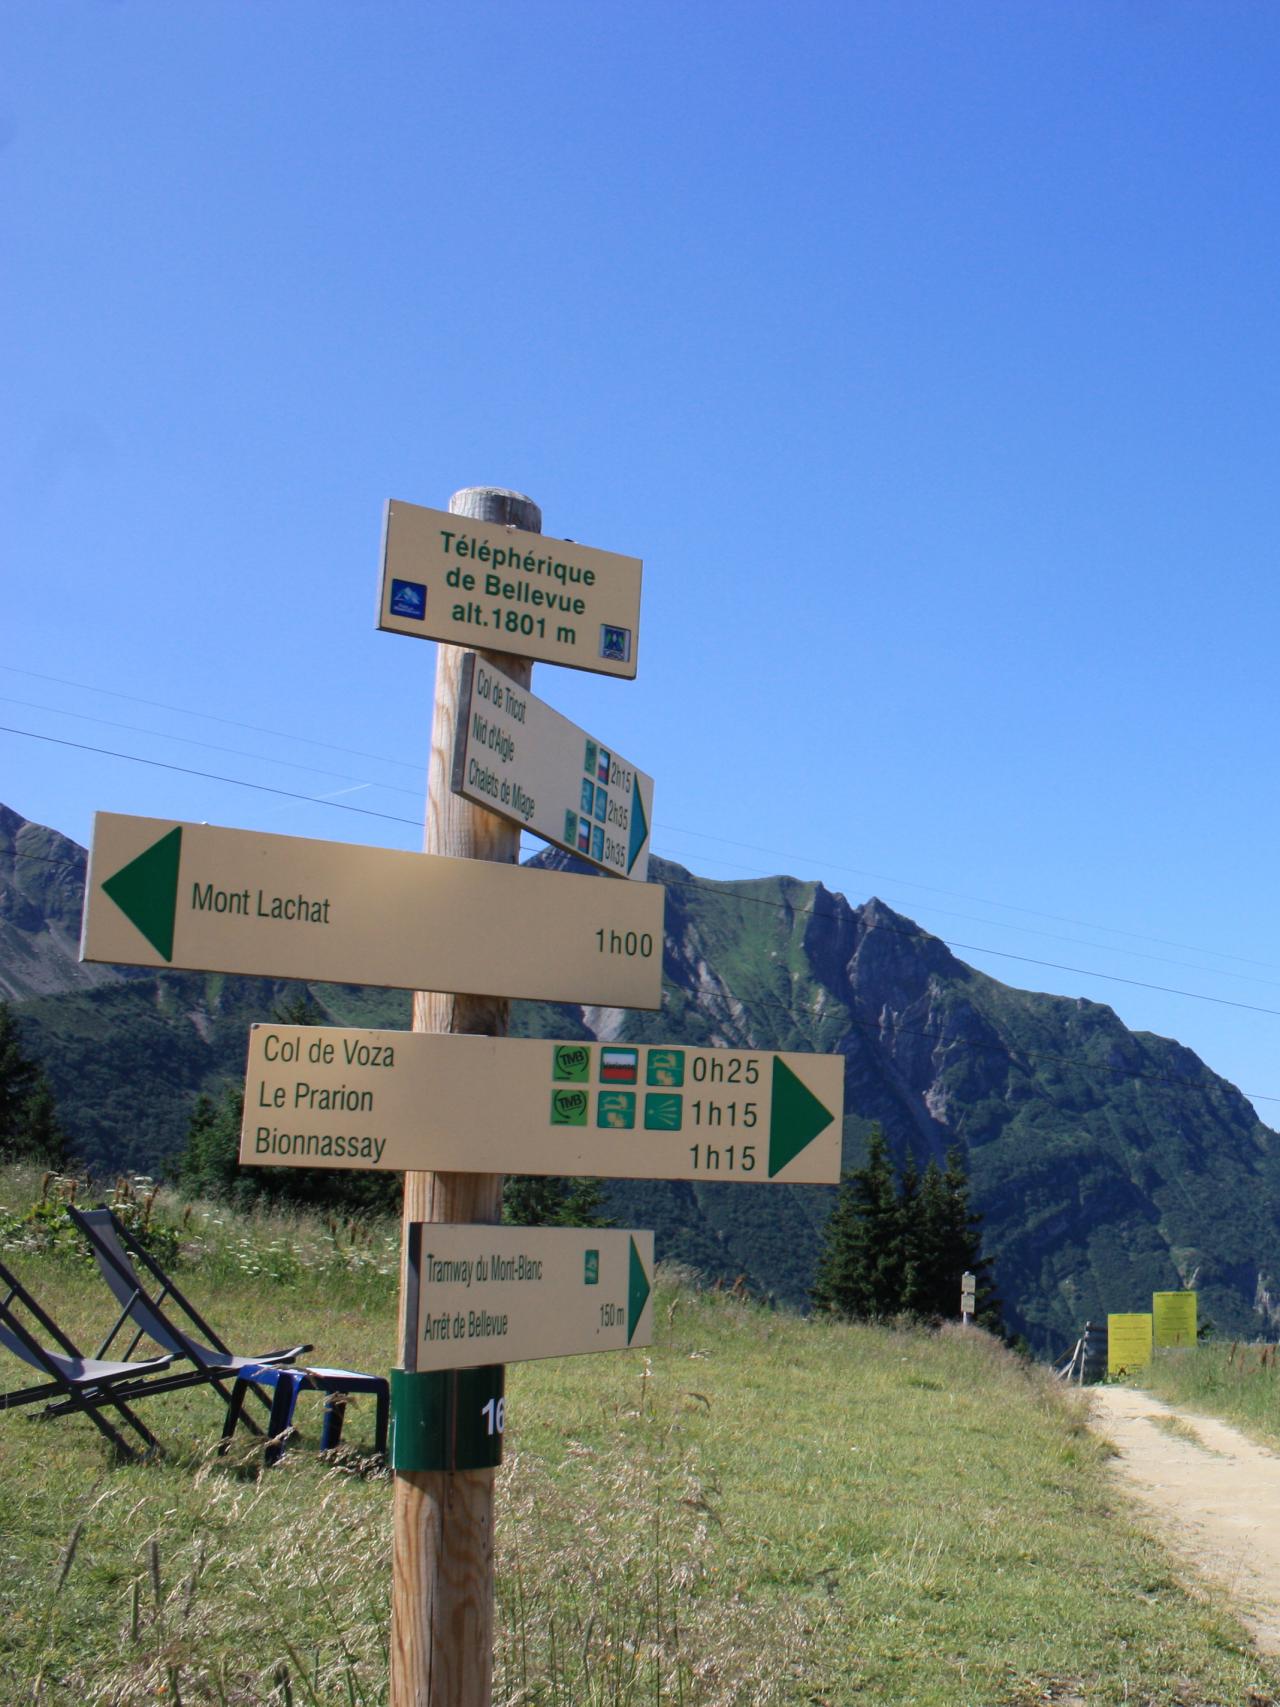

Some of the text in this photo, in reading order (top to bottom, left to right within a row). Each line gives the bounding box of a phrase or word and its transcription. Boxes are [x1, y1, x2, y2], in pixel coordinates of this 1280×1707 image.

[440, 531, 596, 586] Téléphérique
[446, 567, 586, 615] de Bellevue
[557, 630, 576, 644] m
[477, 669, 526, 725] Col de Tricot
[473, 713, 515, 763] Nid d'Aigle
[469, 758, 535, 820] Chalets de Miage
[611, 762, 631, 793] 2h15
[608, 800, 628, 830] 2h35
[605, 838, 626, 867] 3h35
[192, 882, 331, 924] Mont Lachat
[596, 928, 652, 957] 1h00
[264, 1034, 395, 1068] Col de Voza
[560, 1050, 584, 1066] TMB
[692, 1056, 760, 1085] 0h25
[259, 1080, 374, 1112] Le Prarion
[558, 1094, 582, 1111] TMB
[691, 1100, 757, 1128] 1h15
[255, 1127, 387, 1164] Bionnassay
[689, 1143, 756, 1172] 1h15
[427, 1253, 543, 1288] Tramway du Mont-Blanc
[424, 1310, 508, 1341] Arrêt de Bellevue
[600, 1304, 625, 1327] 150 m
